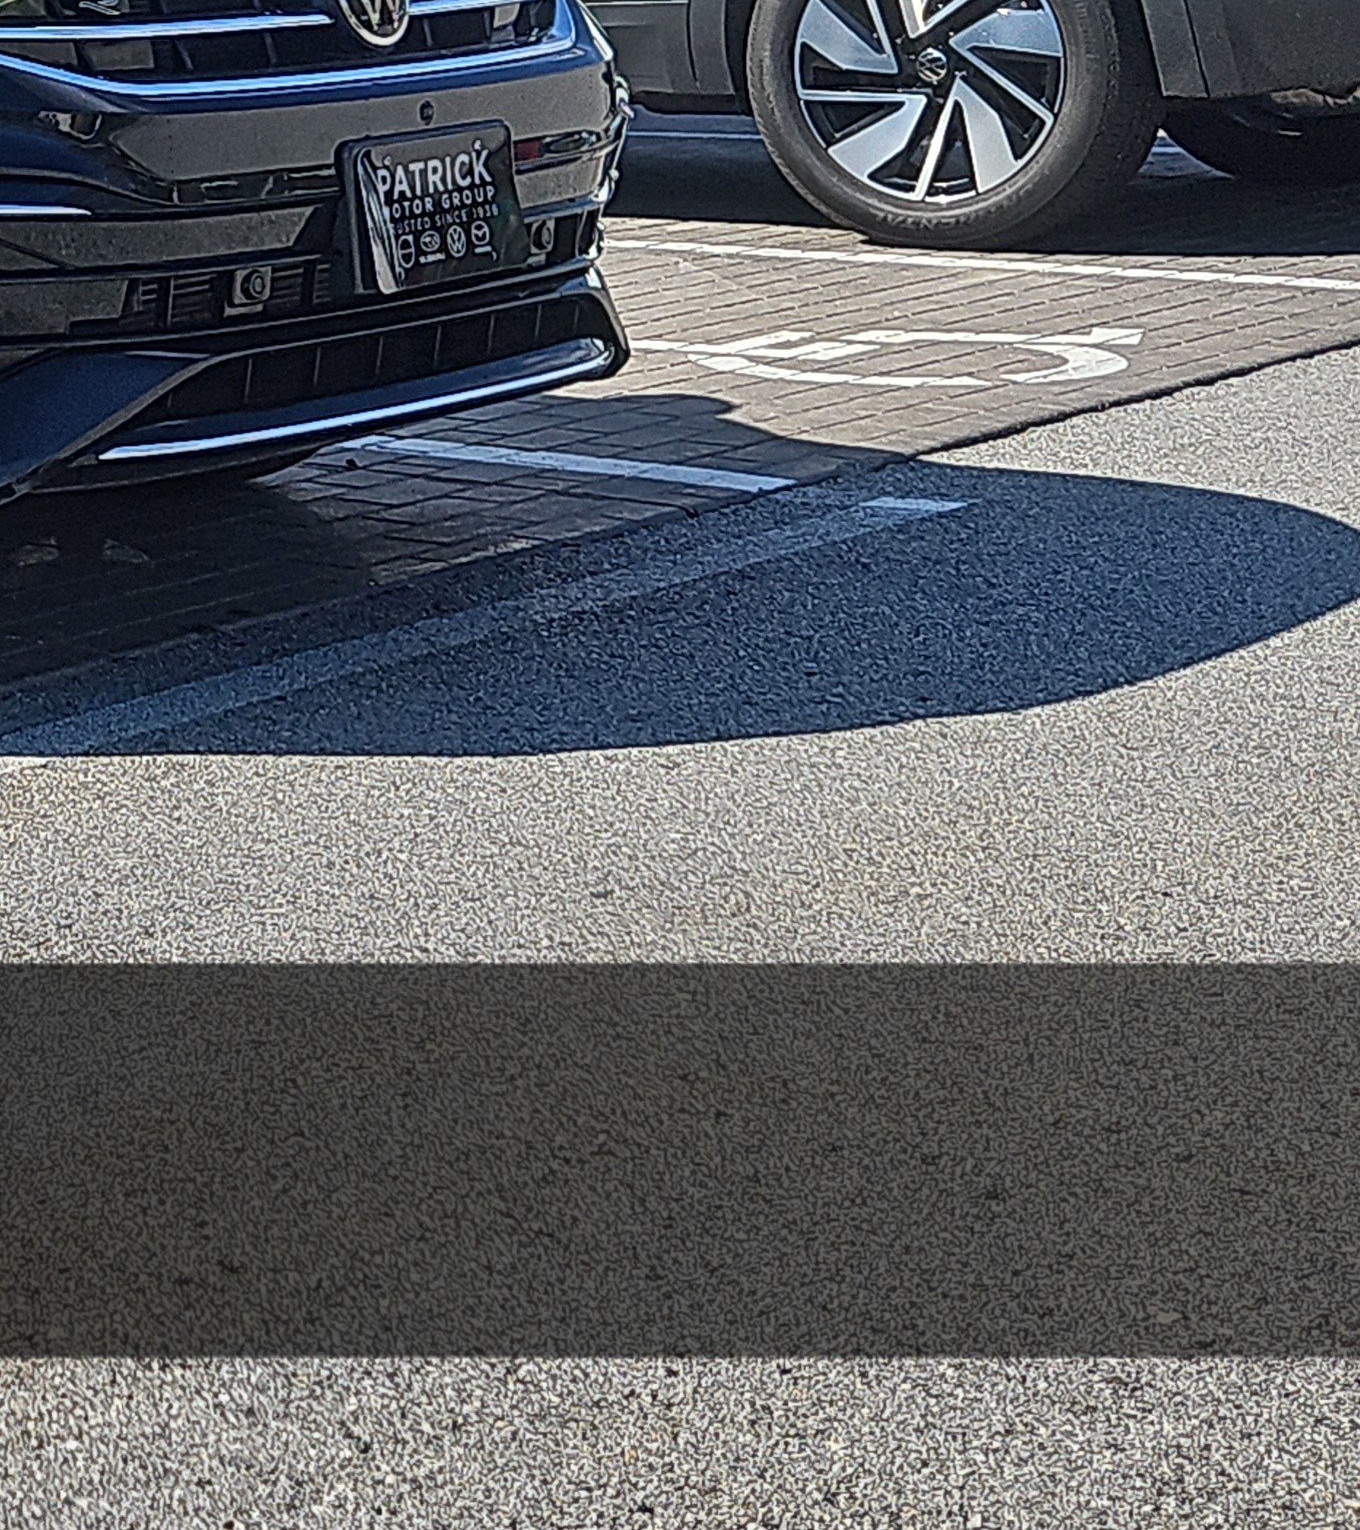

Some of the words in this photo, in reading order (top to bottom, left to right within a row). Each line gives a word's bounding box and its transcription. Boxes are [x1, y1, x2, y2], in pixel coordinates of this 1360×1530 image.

[376, 148, 493, 200] PATRICK
[387, 197, 434, 219] OTOR
[441, 185, 497, 210] GROUP
